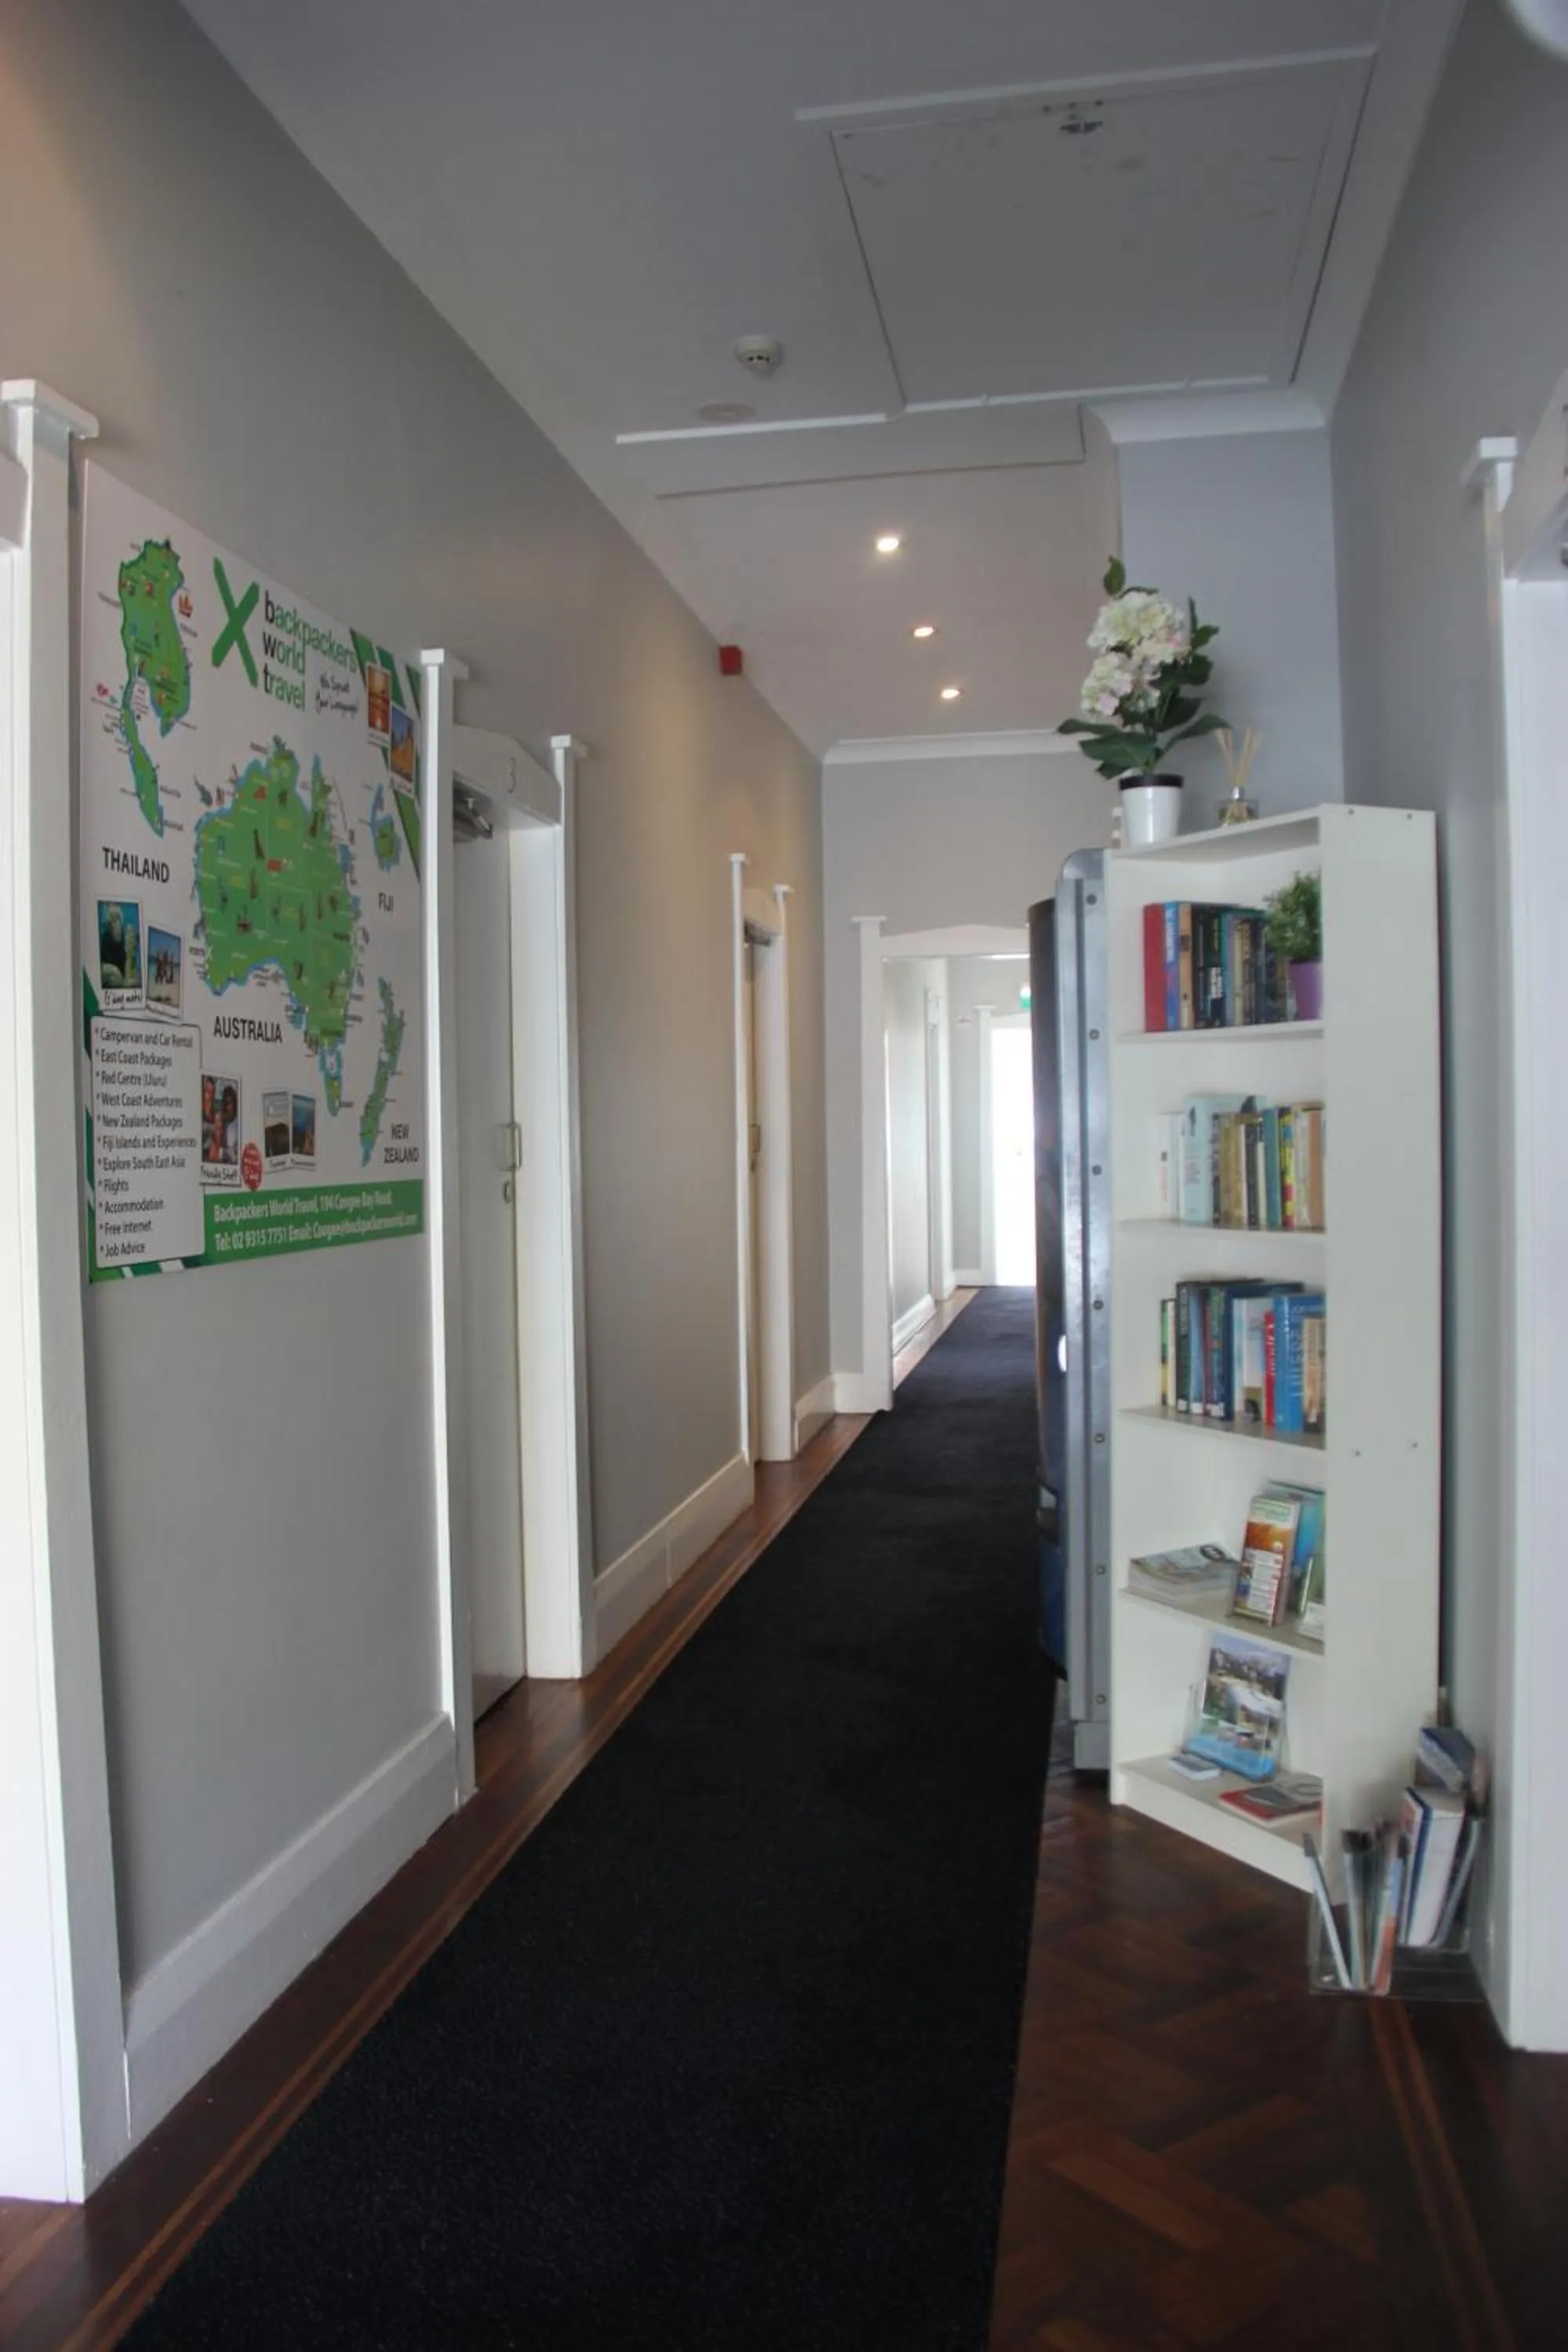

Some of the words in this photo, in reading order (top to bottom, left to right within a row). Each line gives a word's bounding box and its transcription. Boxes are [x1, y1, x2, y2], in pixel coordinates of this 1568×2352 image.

[265, 590, 358, 673] backpackers
[263, 631, 305, 676] world
[263, 663, 305, 713] travel
[102, 846, 170, 884] THAILAND
[100, 1028, 143, 1044] Campervan
[144, 1033, 157, 1045] and
[159, 1033, 170, 1046] Car
[172, 1034, 194, 1048] Rental
[213, 1015, 283, 1044] AUSTRALIA
[100, 1049, 117, 1063] East
[118, 1049, 139, 1064] Coast
[140, 1051, 172, 1069] Packages
[101, 1070, 116, 1084] Red
[118, 1071, 142, 1086] Centre
[101, 1091, 120, 1106] West
[122, 1093, 142, 1106] Coast
[102, 1113, 118, 1127] New
[120, 1113, 150, 1127] Zealand
[151, 1114, 183, 1131] Packages
[391, 1122, 410, 1141] NEW
[143, 1137, 156, 1149] and
[384, 1147, 419, 1164] ZEALAND
[103, 1156, 131, 1174] Explore
[132, 1156, 154, 1170] South
[155, 1156, 170, 1169] East
[171, 1156, 187, 1167] Asia
[103, 1178, 129, 1196] Flights
[104, 1198, 164, 1214] Accommodation
[214, 1200, 268, 1225] Backpackers
[269, 1198, 293, 1217] World
[104, 1221, 122, 1236] Free
[105, 1243, 119, 1258] Job
[121, 1241, 146, 1255] Advice
